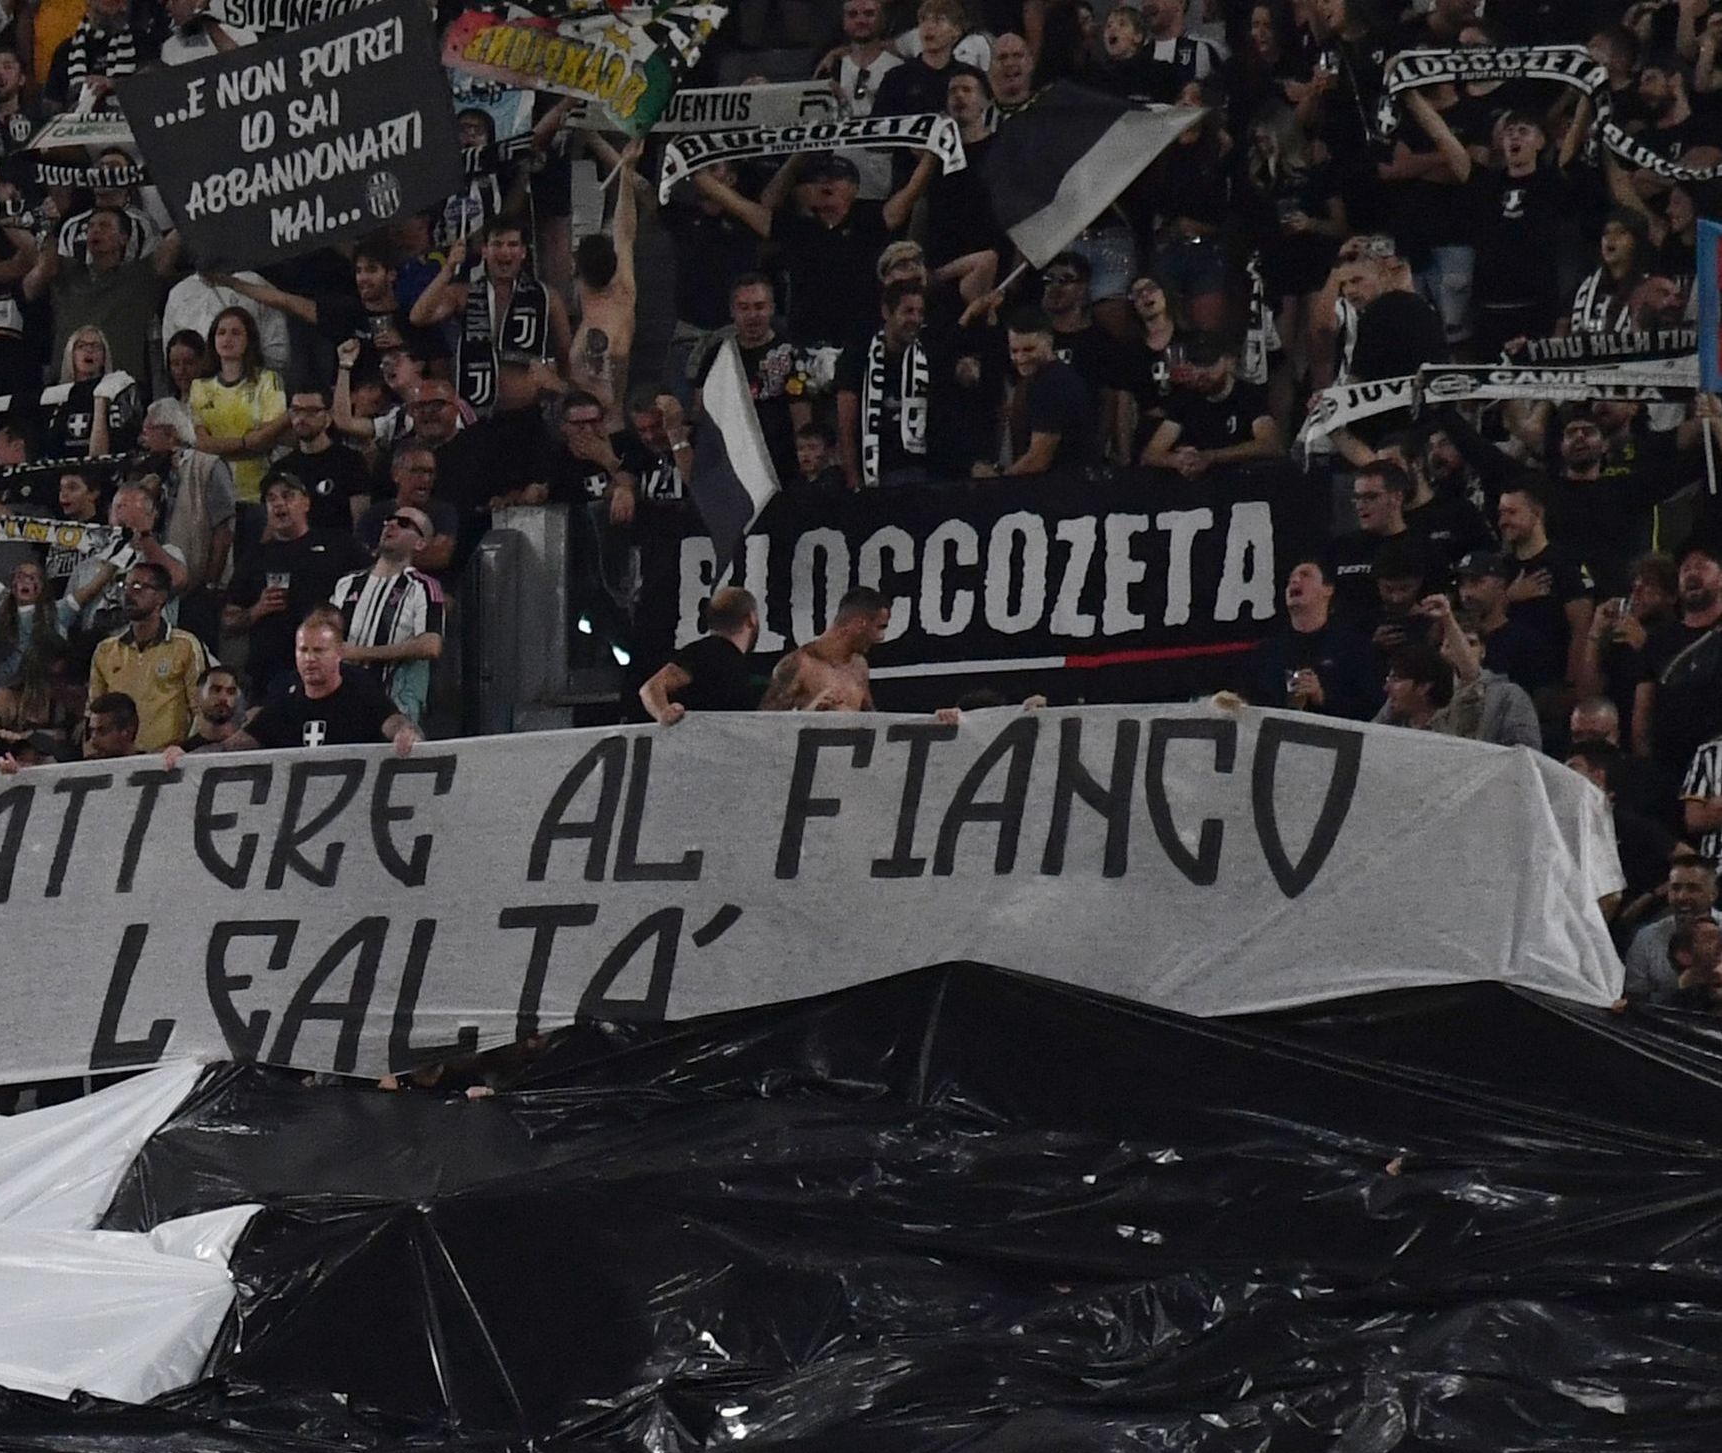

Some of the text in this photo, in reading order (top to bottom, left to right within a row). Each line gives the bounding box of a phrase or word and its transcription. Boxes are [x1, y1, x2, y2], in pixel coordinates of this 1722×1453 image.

[216, 58, 289, 113] NON
[299, 17, 404, 93] POTREI
[662, 92, 753, 123] VENTUS
[185, 110, 423, 220] ABBANDONARTI
[240, 90, 341, 152] LO SAI
[529, 735, 704, 884] AL
[775, 717, 1363, 899] FIANCO
